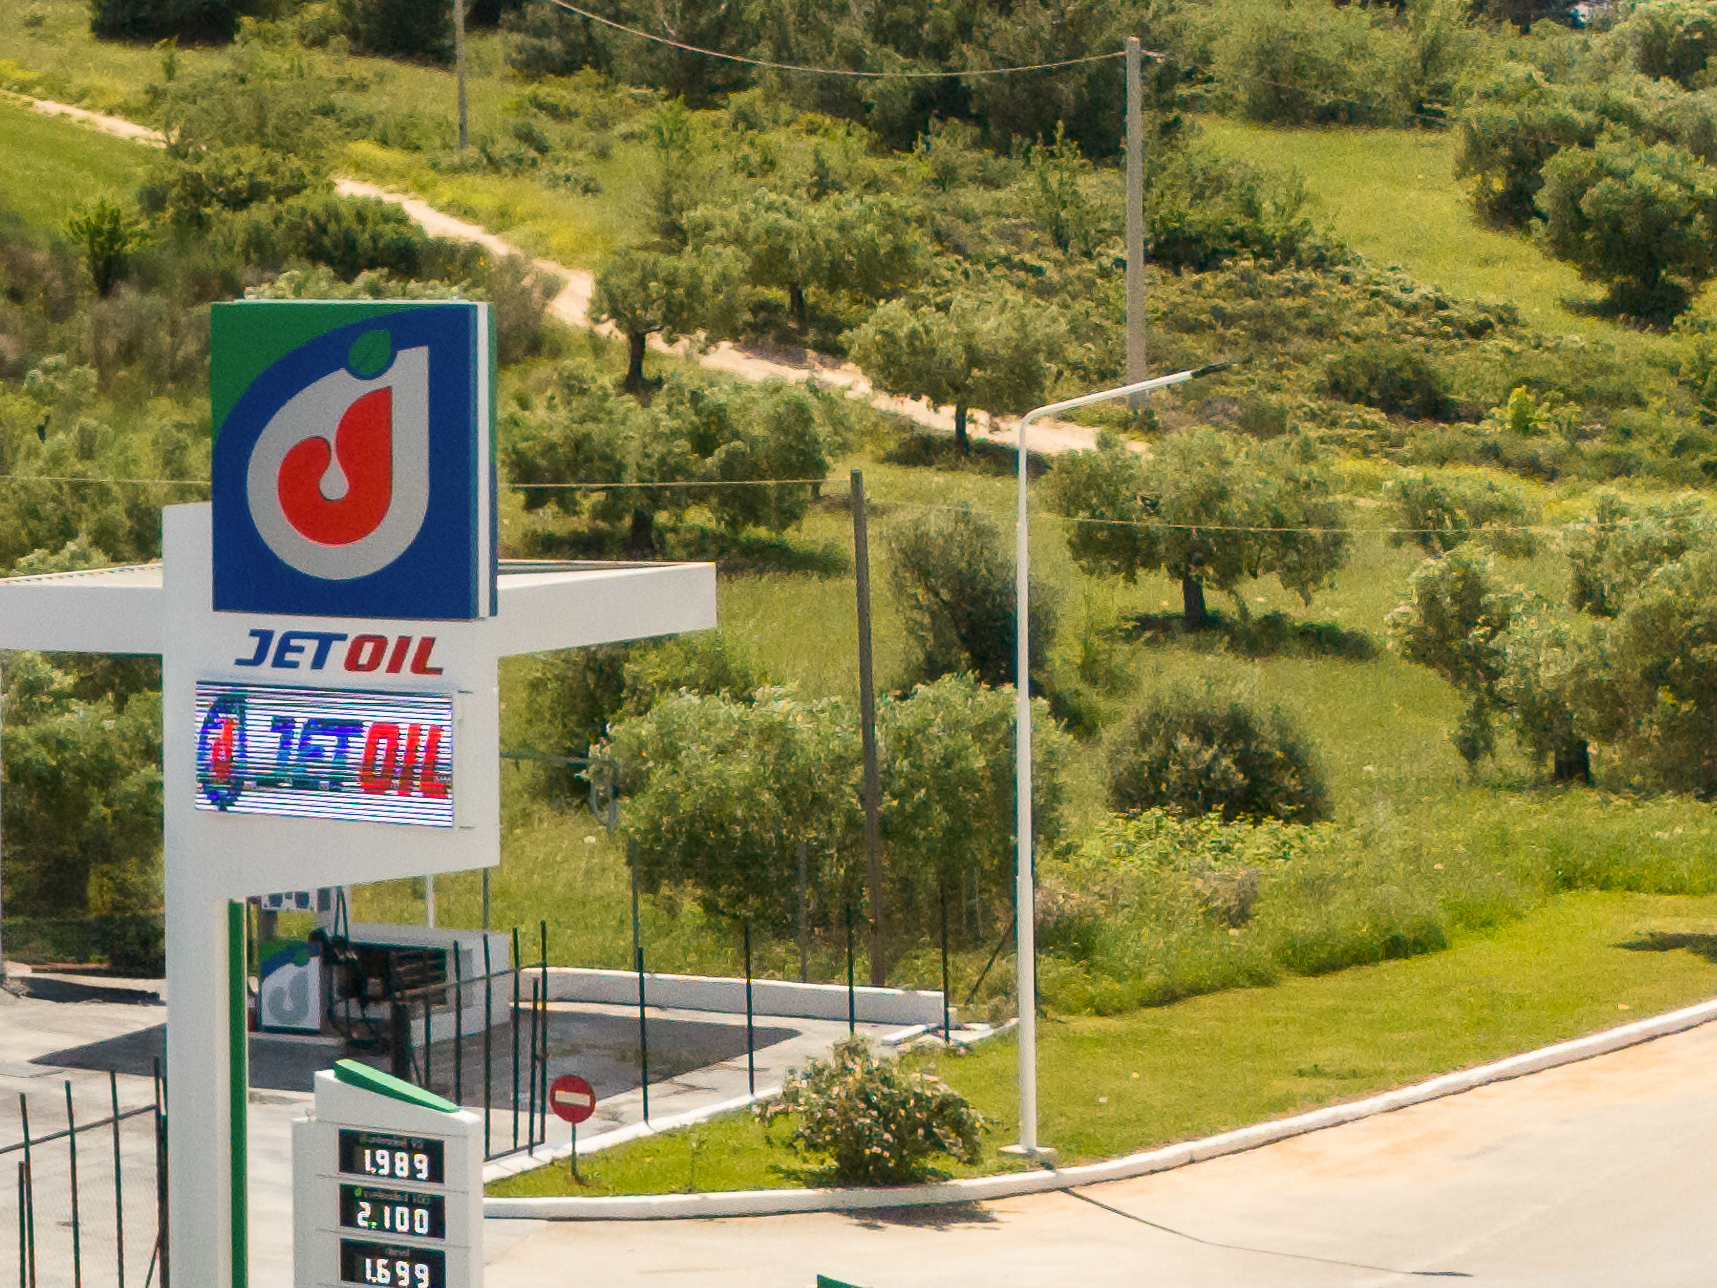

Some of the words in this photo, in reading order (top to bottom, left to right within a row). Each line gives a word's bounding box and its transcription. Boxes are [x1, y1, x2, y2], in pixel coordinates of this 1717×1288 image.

[234, 629, 443, 676] JETOIL
[364, 1149, 428, 1180] 1.989
[357, 1201, 429, 1234] 2.100
[365, 1258, 430, 1288] 1.699
